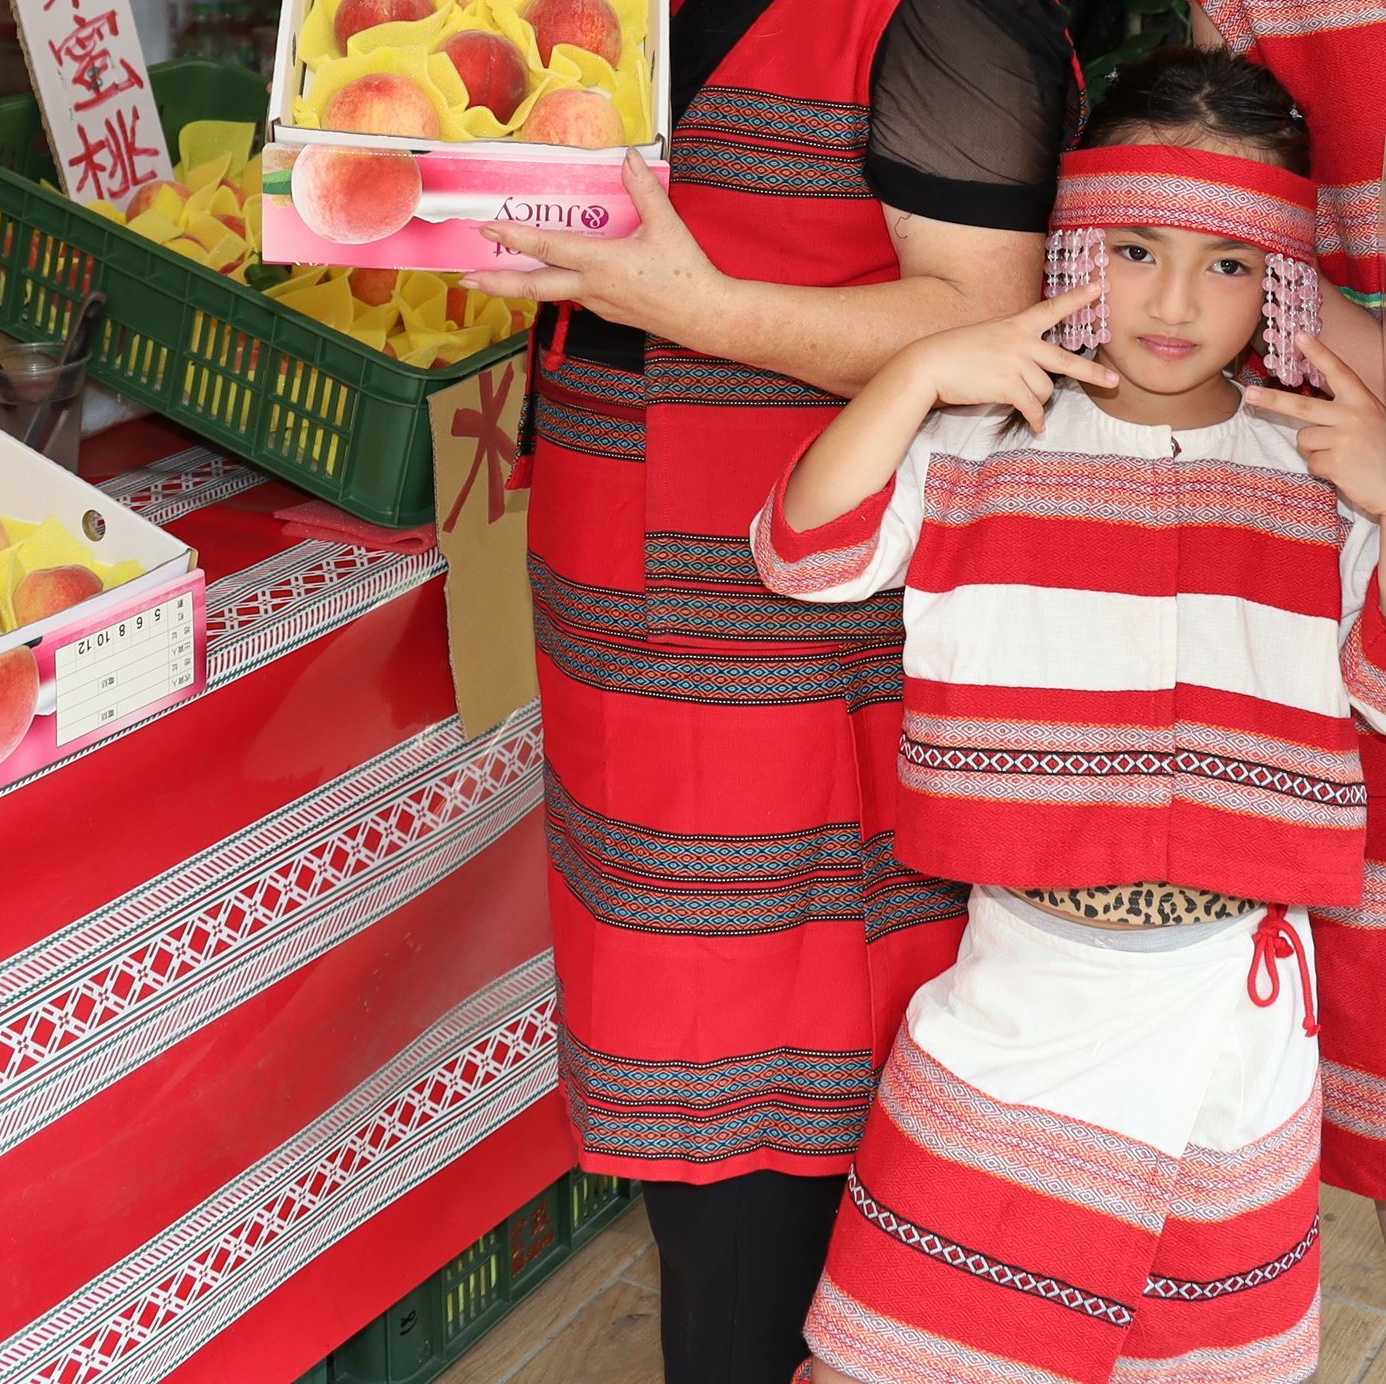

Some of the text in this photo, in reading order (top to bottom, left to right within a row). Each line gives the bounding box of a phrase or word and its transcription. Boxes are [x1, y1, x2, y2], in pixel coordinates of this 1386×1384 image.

[443, 362, 515, 534] 水
[78, 608, 161, 655] 5 6 8 10 12
